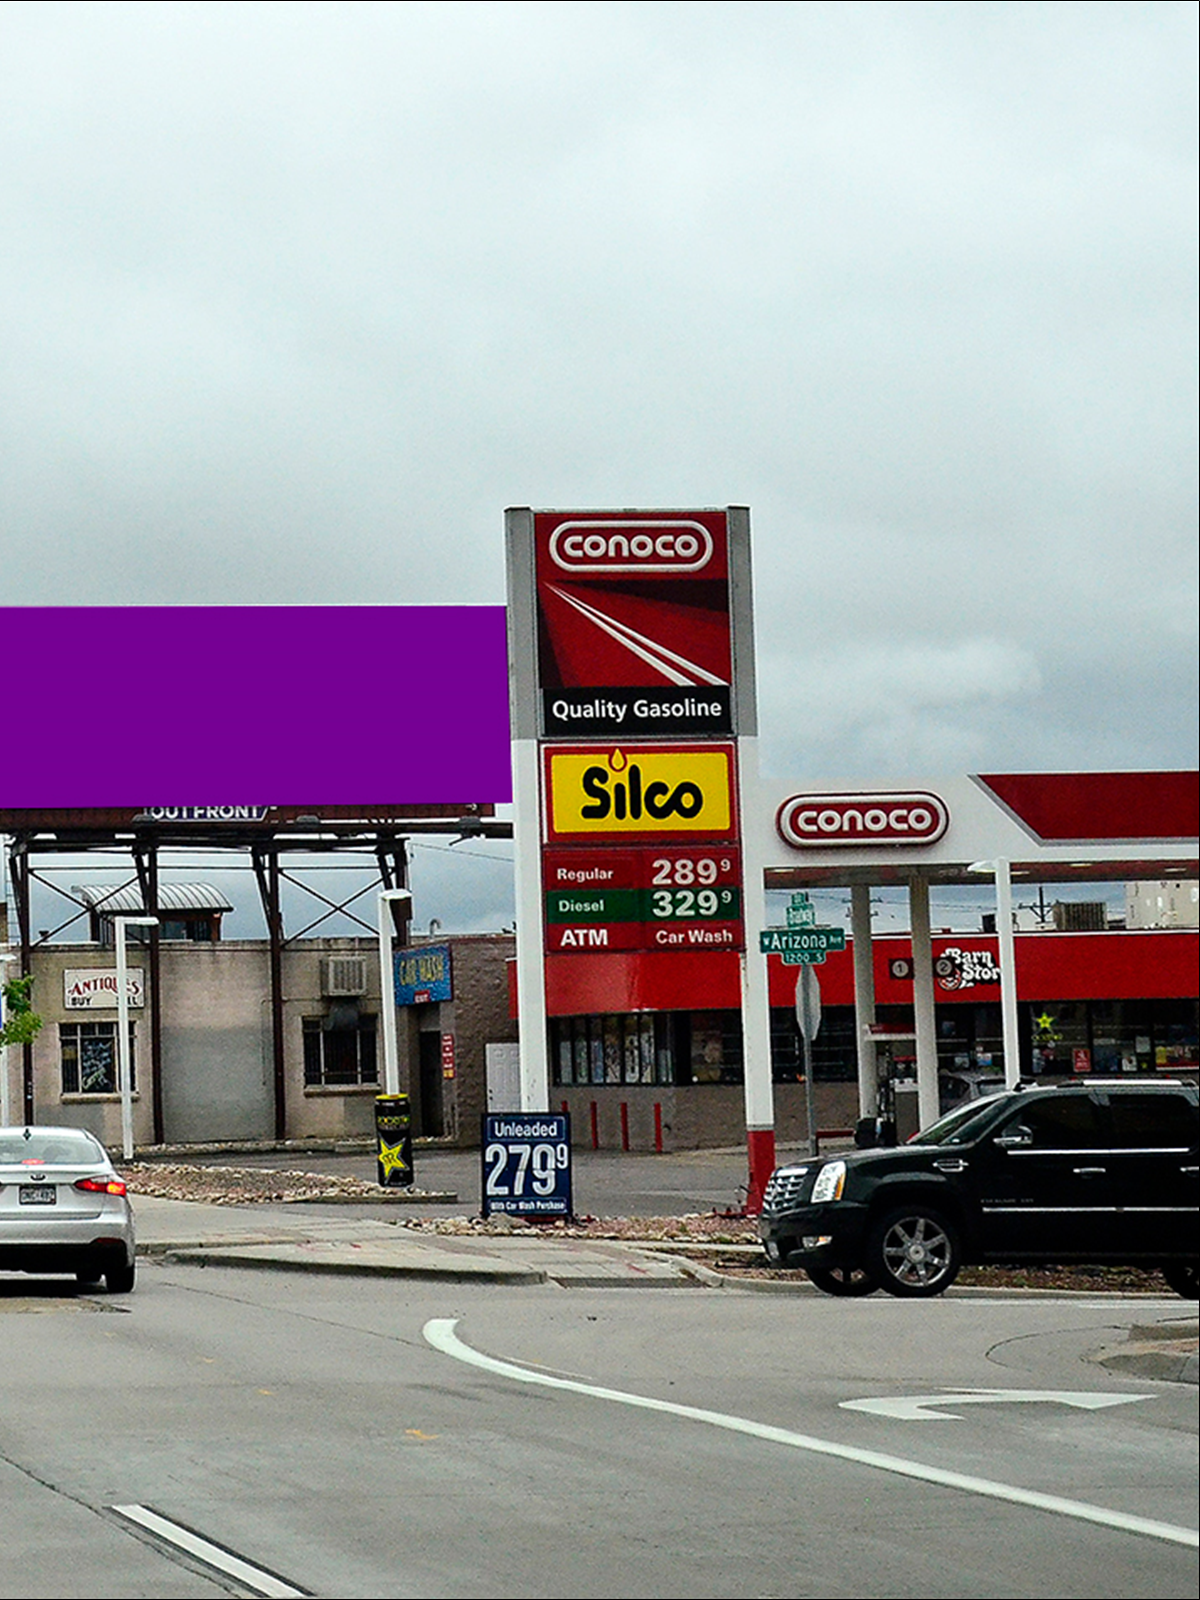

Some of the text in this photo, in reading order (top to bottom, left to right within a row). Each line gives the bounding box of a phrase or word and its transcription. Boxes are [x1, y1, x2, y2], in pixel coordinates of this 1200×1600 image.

[564, 535, 698, 557] conoco
[552, 698, 722, 723] Quality Gasoline
[581, 764, 704, 820] Silco
[797, 808, 932, 832] conoco
[557, 868, 613, 882] Regular
[558, 899, 604, 912] Diesel
[560, 929, 608, 946] ATM
[655, 929, 733, 944] Car Wash
[771, 933, 827, 949] Arizona
[785, 953, 809, 962] 1200
[962, 965, 1000, 980] Stor
[67, 976, 140, 996] ANTIQS
[71, 997, 92, 1006] BUY
[494, 1121, 557, 1137] Unleaded
[506, 1201, 517, 1210] Car
